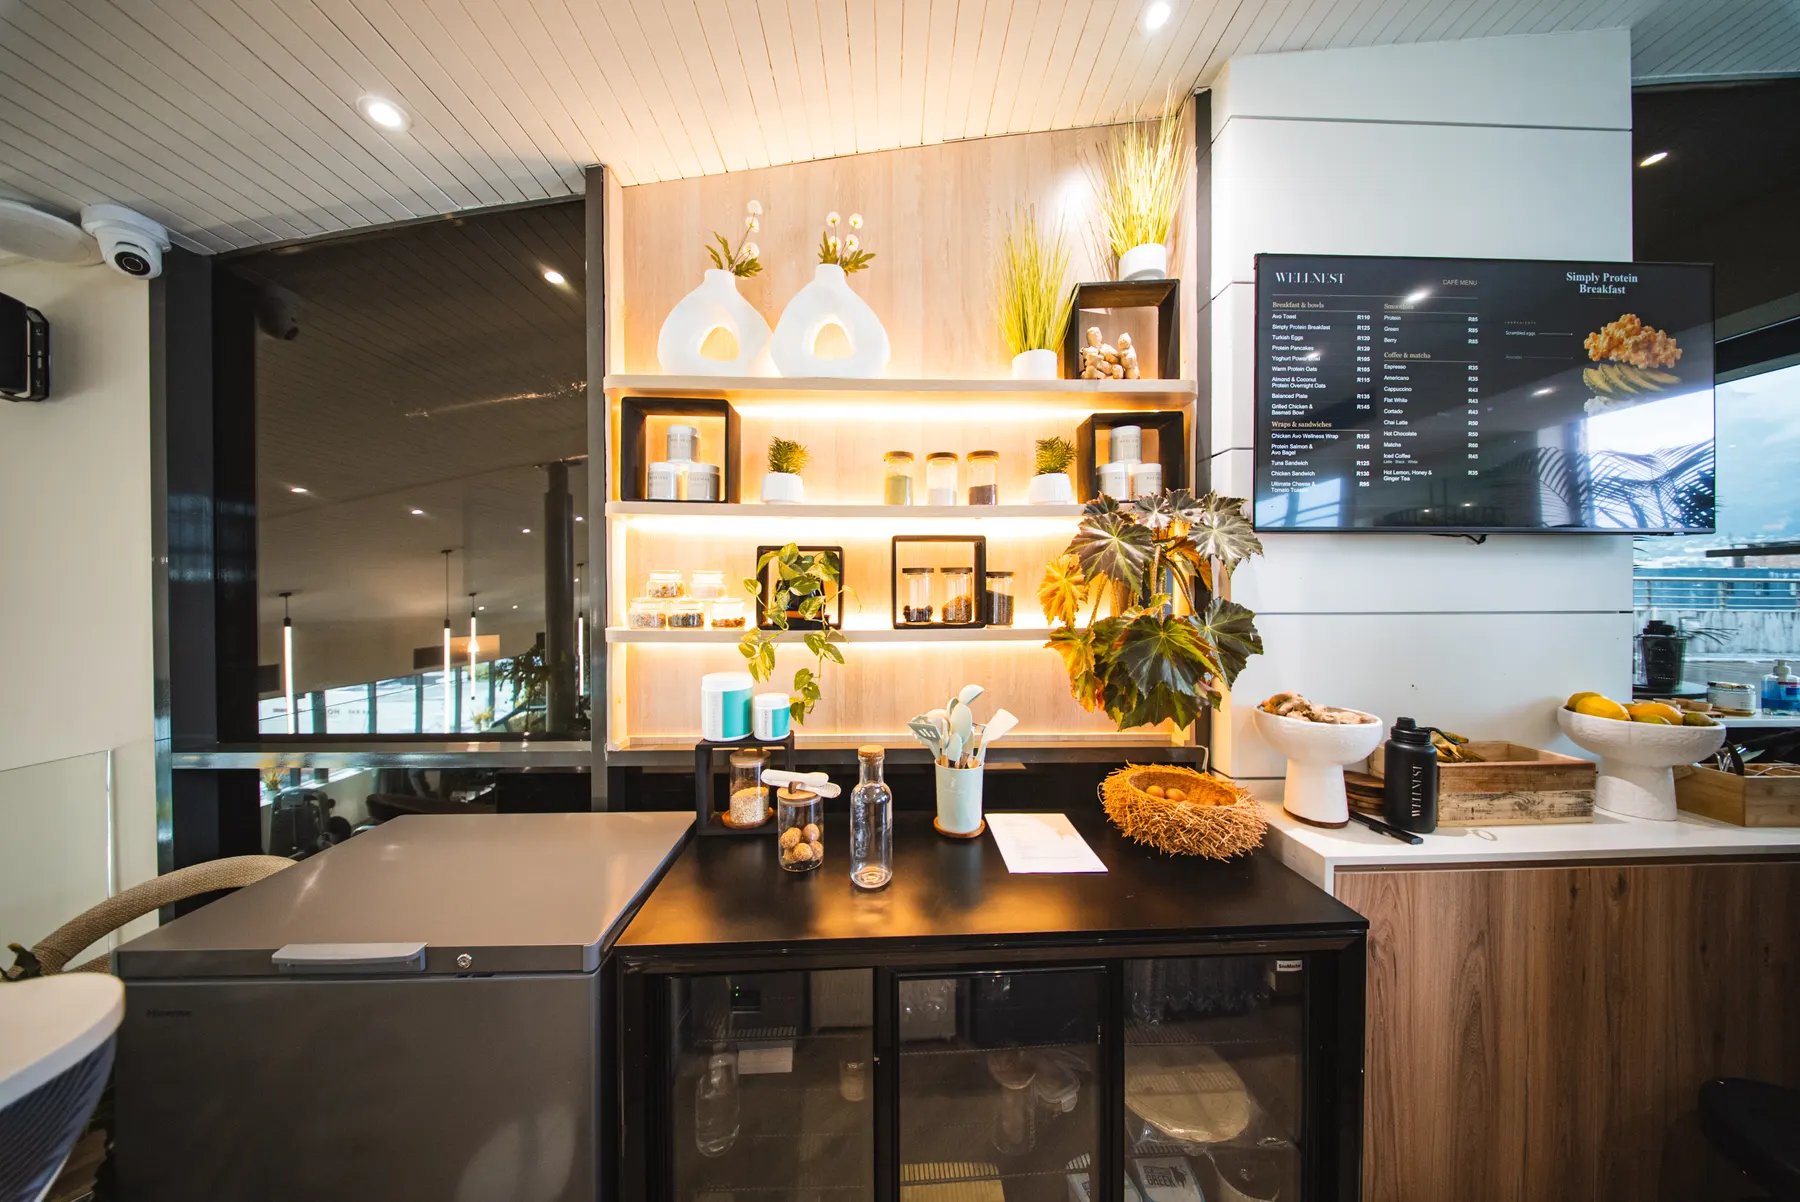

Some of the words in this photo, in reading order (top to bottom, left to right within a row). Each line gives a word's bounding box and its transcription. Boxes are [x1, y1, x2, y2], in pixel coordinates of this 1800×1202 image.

[1276, 272, 1345, 283] WELLNEST
[1566, 272, 1600, 283] Simply
[1603, 273, 1638, 283] Protein
[1579, 284, 1625, 294] Breakfast
[1412, 764, 1422, 817] WELLNEST
[1148, 1175, 1175, 1187] GREEK
